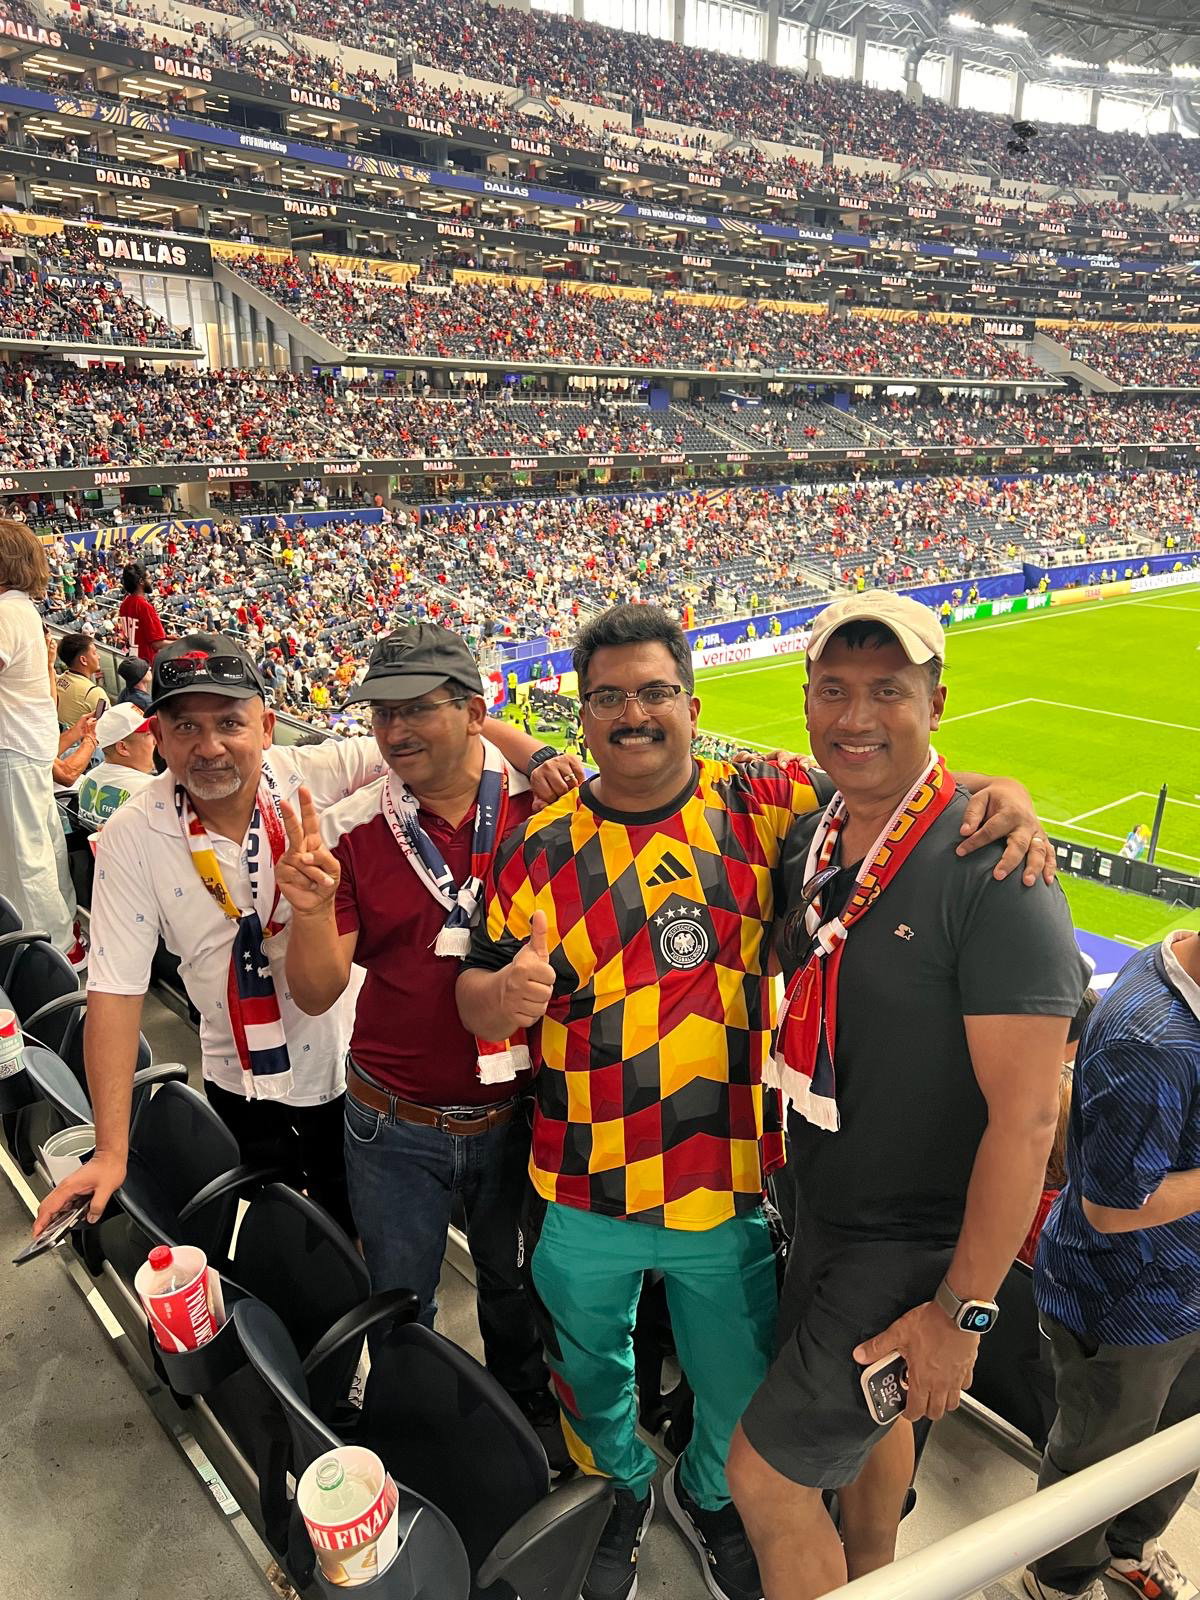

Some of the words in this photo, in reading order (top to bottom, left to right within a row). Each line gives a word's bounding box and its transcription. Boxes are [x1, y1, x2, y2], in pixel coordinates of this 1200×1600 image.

[154, 56, 212, 82] DALLAS
[290, 88, 340, 112] DALLAS
[408, 115, 452, 136] DALLAS
[510, 138, 550, 156] DALLAS
[604, 156, 640, 174] DALLAS
[96, 169, 150, 190] DALLAS
[688, 172, 721, 188] DALLAS
[484, 181, 529, 198] DALLAS
[766, 186, 798, 200] DALLAS
[284, 200, 328, 216] DALLAS
[839, 197, 869, 210] DALLAS
[638, 206, 652, 217] FIFA
[652, 209, 674, 221] WORLD
[674, 212, 686, 222] CUP
[908, 207, 936, 219] DALLAS
[975, 215, 1002, 227] DALLAS
[1039, 222, 1066, 234] DALLAS
[437, 224, 475, 239] DALLAS
[799, 230, 833, 241] DALLAS
[1102, 230, 1128, 240] DALLAS
[1169, 234, 1200, 244] DALLAS
[97, 237, 187, 266] DALLAS
[568, 242, 600, 255] DALLAS
[682, 256, 712, 268] DALLAS
[1090, 260, 1120, 269] DALLAS
[882, 276, 907, 286] DALLAS
[983, 322, 1024, 336] DALLAS
[324, 464, 358, 474] DALLAS
[423, 461, 454, 471] DALLAS
[510, 459, 538, 469] DALLAS
[94, 471, 130, 486] DALLAS
[208, 466, 248, 479] DALLAS
[703, 634, 720, 647] FIFA
[772, 636, 809, 654] verizo
[702, 646, 752, 667] verizon
[185, 1282, 211, 1328] FINAL
[882, 1373, 902, 1407] 2:58
